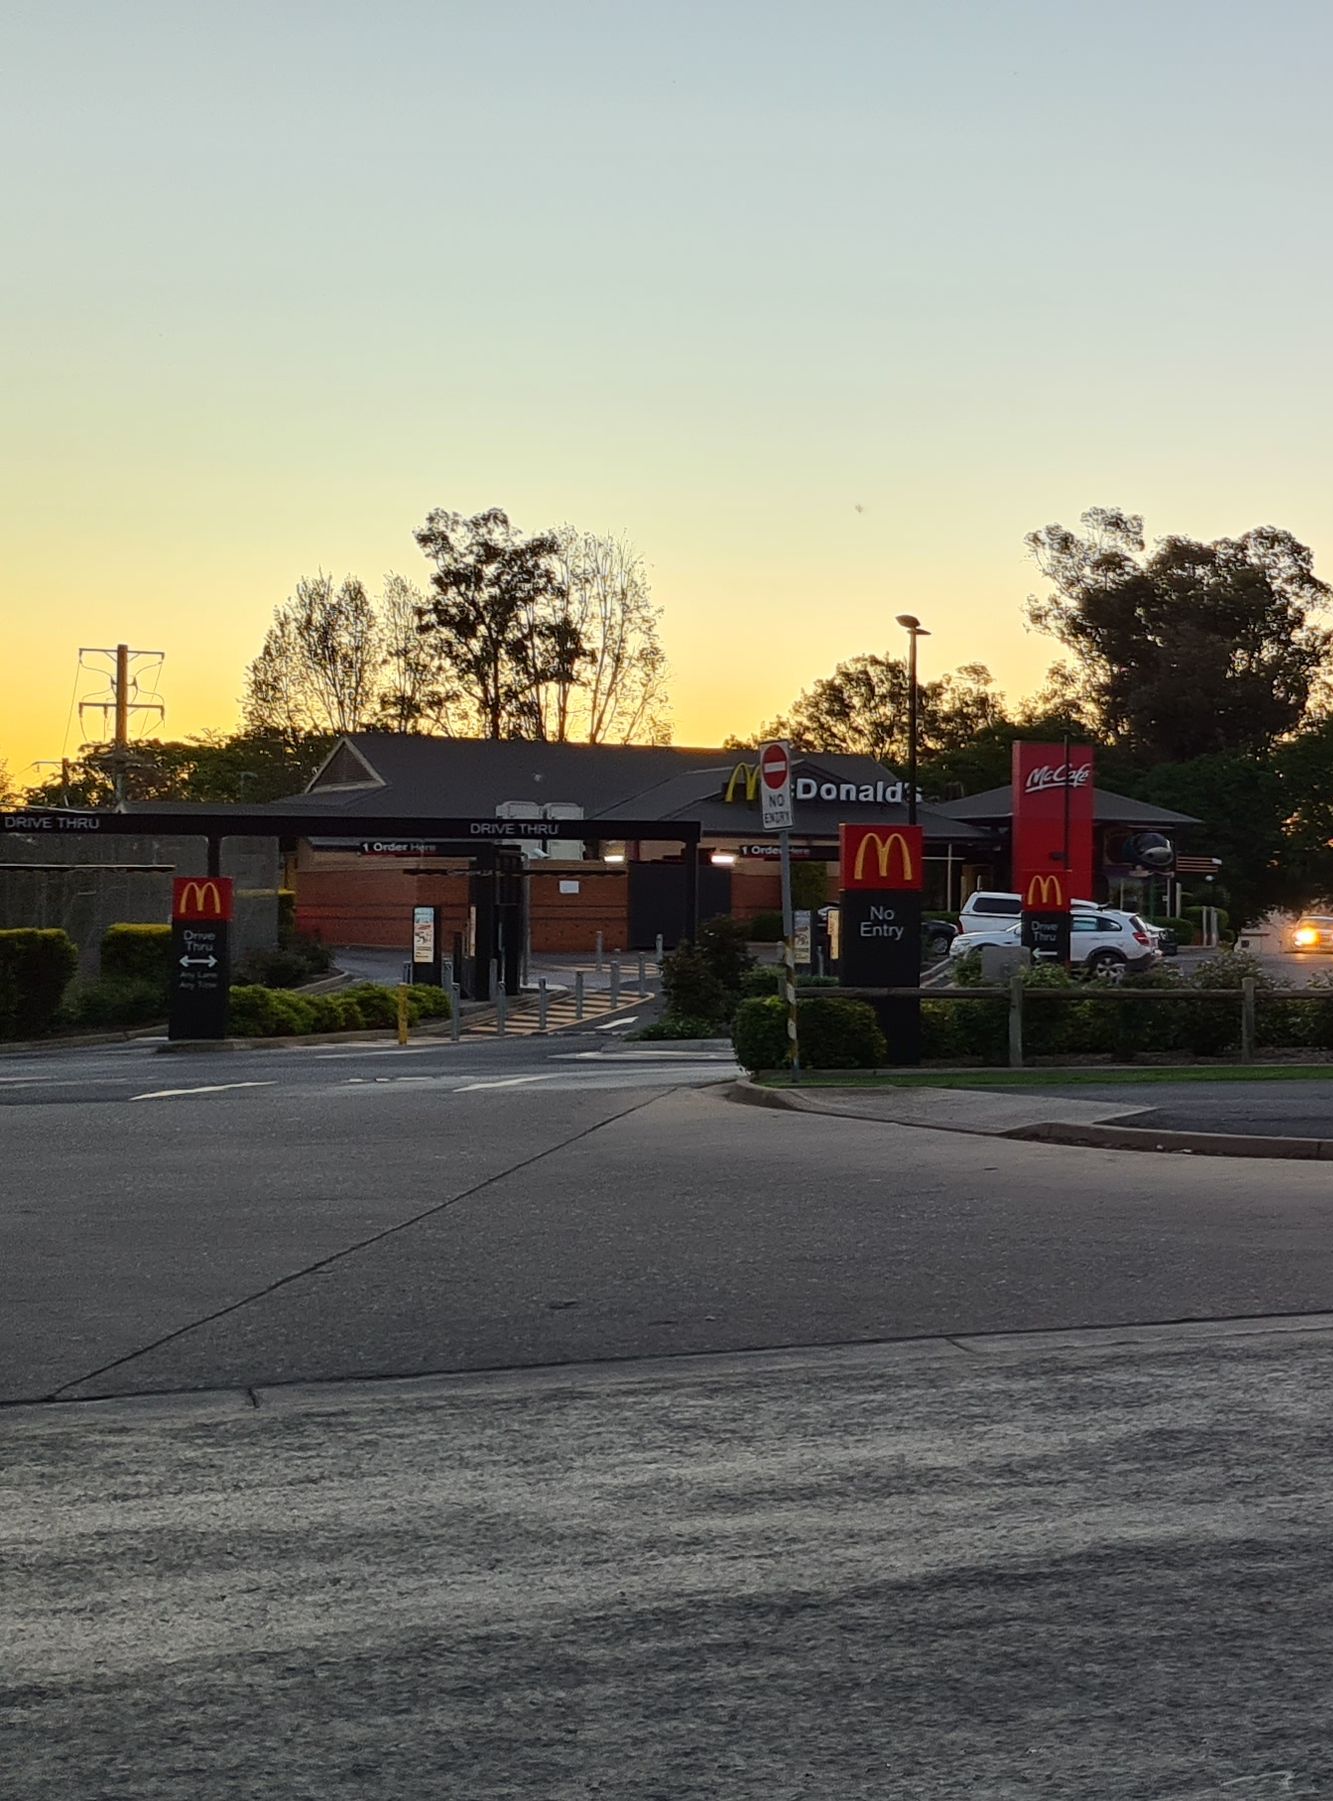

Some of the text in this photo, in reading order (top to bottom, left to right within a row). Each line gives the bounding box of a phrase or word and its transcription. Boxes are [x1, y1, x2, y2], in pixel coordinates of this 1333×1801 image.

[768, 793, 785, 807] NO
[4, 816, 100, 830] DRIVE THRU
[764, 811, 790, 824] ENTRY
[469, 823, 560, 835] DRIVE THRU
[373, 842, 409, 852] Order
[869, 905, 895, 920] No
[183, 929, 216, 941] Drive
[860, 921, 904, 940] Entry
[185, 942, 214, 953] Thru
